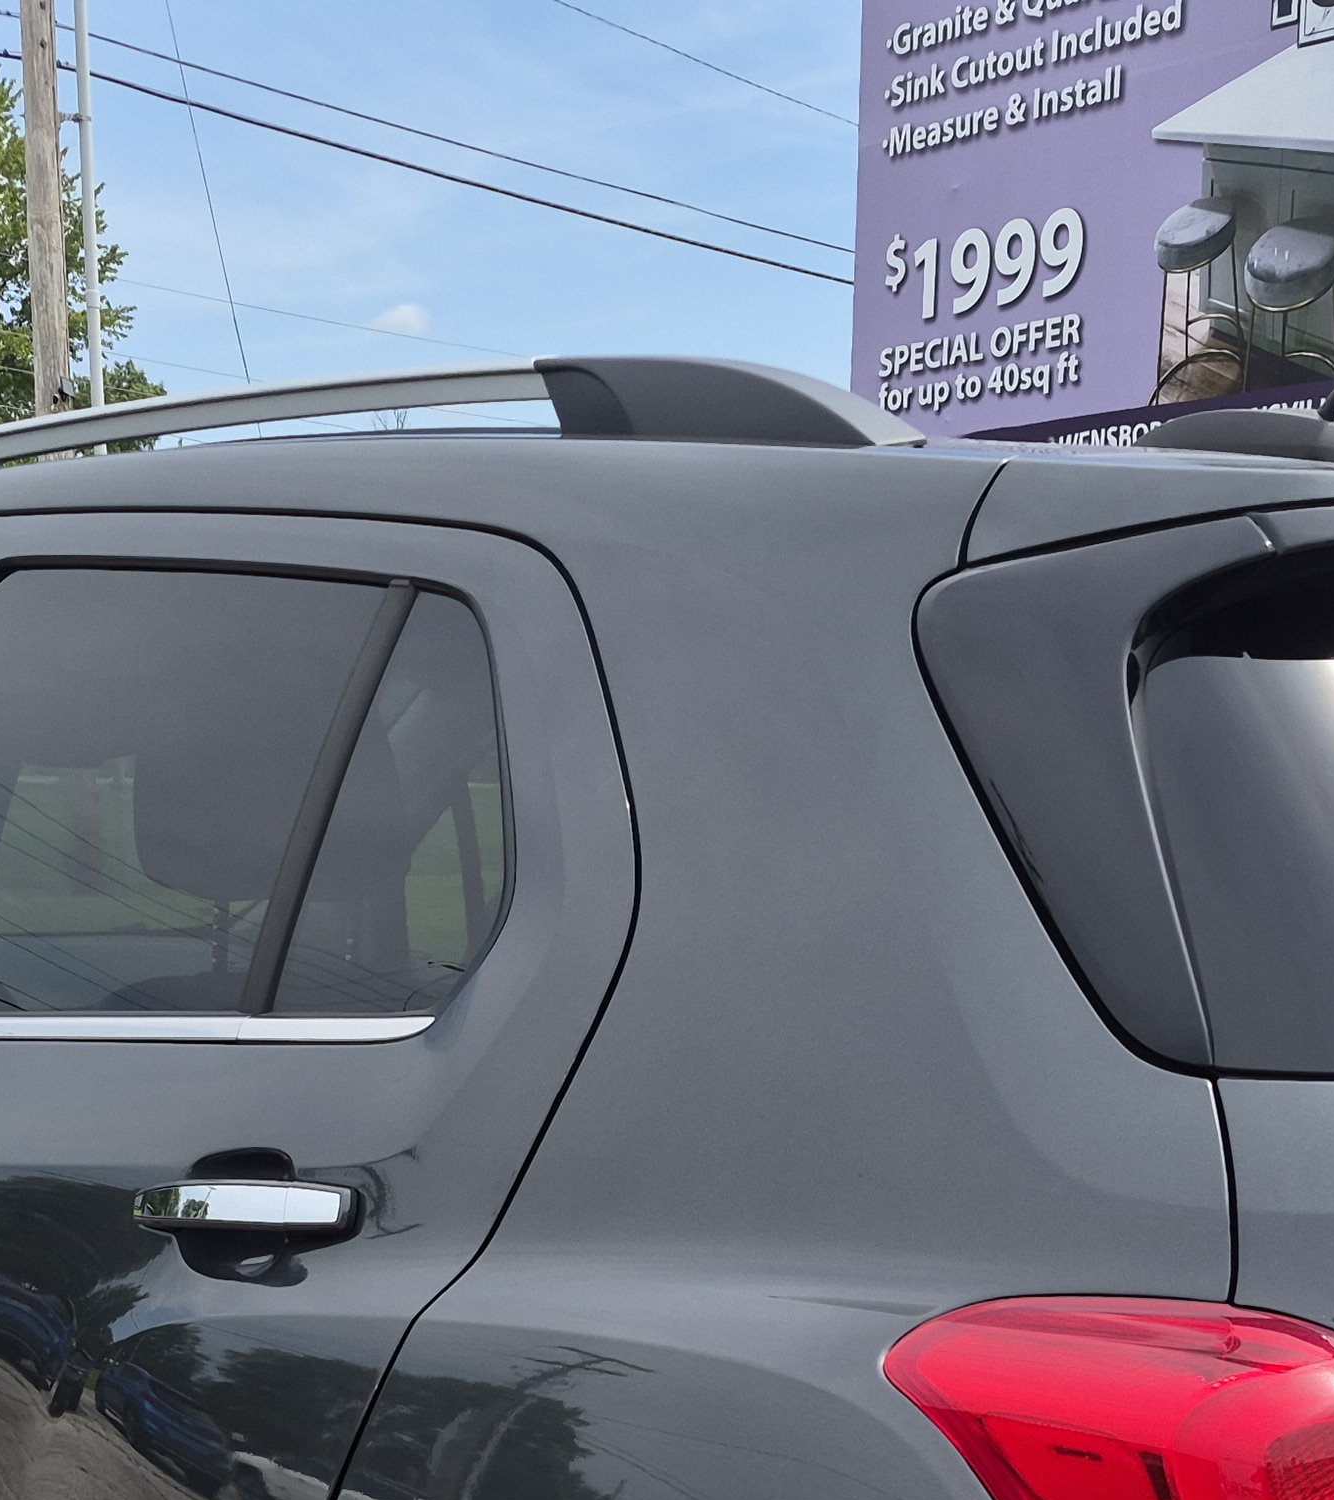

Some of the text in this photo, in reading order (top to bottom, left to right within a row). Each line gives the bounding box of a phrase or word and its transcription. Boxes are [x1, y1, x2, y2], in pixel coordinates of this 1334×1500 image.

[890, 0, 1183, 107] Sink Cutout Included
[892, 6, 988, 55] Granite
[995, 0, 1016, 25] &
[889, 64, 1123, 157] Measure & Install
[878, 313, 1081, 378] SPECIAL OFFER
[878, 351, 1079, 411] for up to 40sq ft
